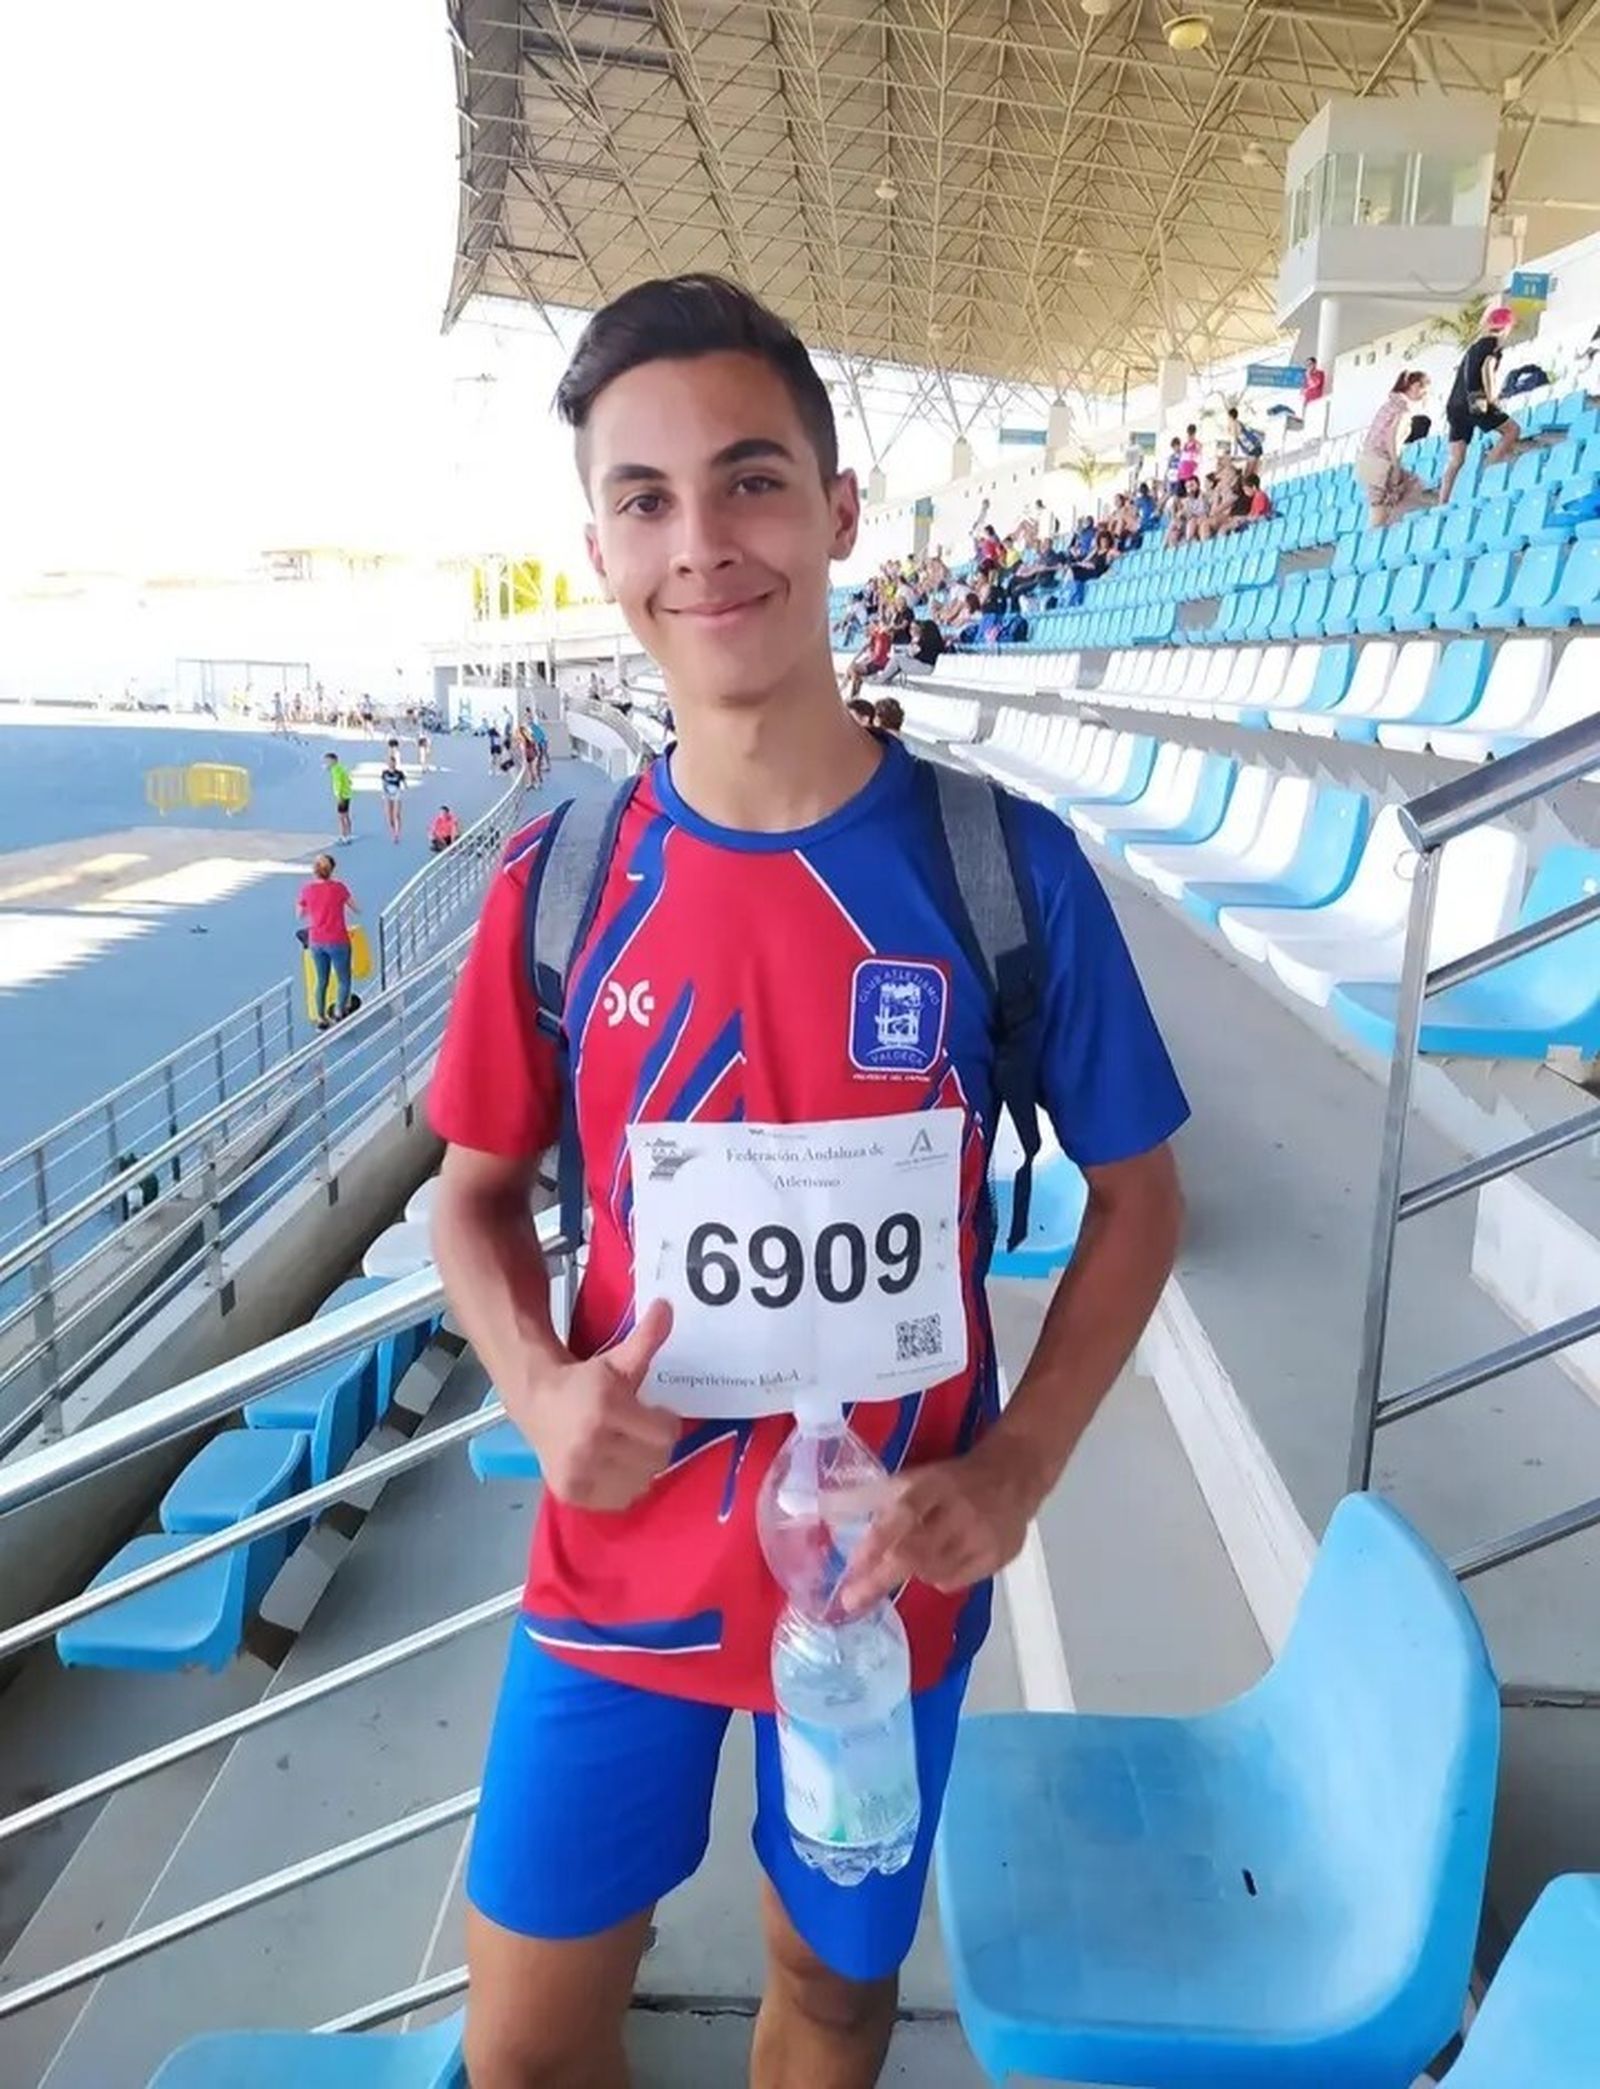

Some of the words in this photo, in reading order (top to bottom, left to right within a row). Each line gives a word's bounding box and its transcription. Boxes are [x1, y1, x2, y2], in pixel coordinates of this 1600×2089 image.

[726, 1148, 799, 1162] Federación
[802, 1146, 866, 1162] Andaluza
[867, 1142, 885, 1156] de
[774, 1175, 841, 1190] Atletismo
[685, 1212, 923, 1309] 6909
[656, 1370, 755, 1388] Competiciones
